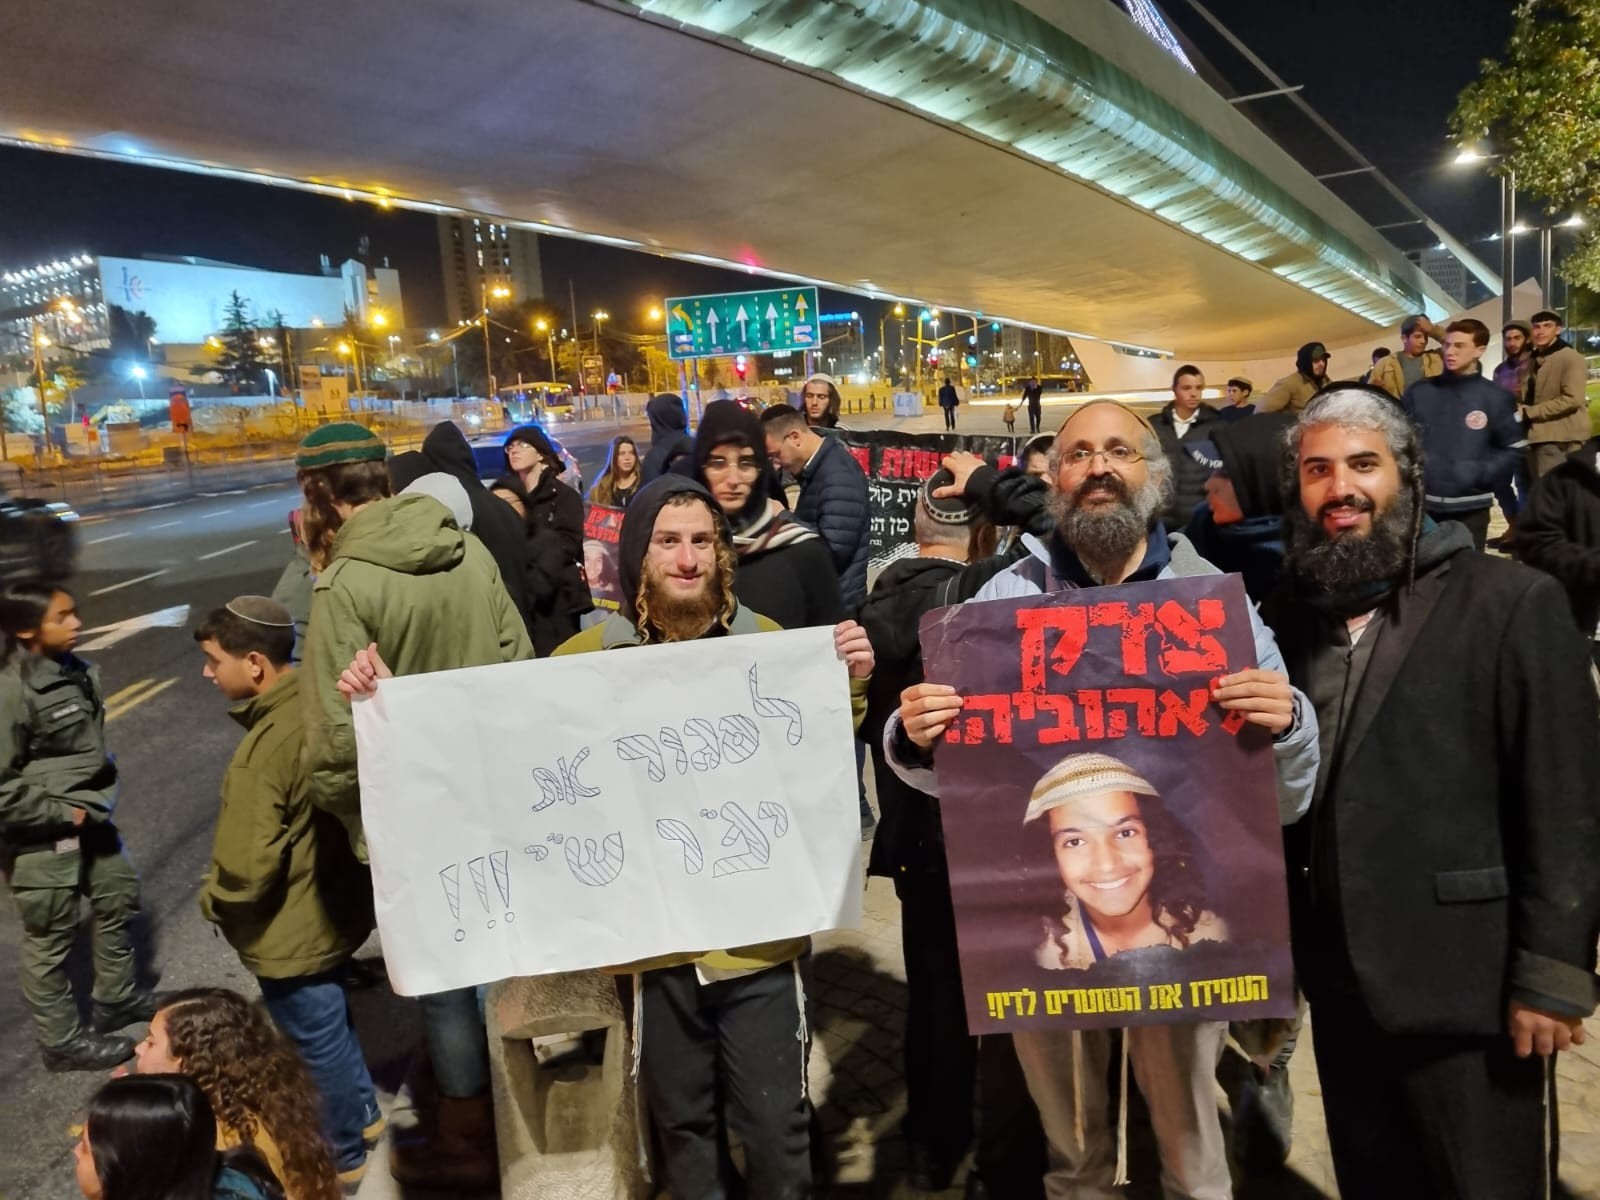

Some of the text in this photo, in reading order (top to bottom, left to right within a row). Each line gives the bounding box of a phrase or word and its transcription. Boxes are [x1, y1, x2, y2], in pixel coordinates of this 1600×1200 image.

[1015, 599, 1229, 698] צדק
[945, 667, 1251, 744] אהוביה
[532, 746, 601, 812] את
[986, 975, 1269, 1019] העמידו את השוטרים לדין!
